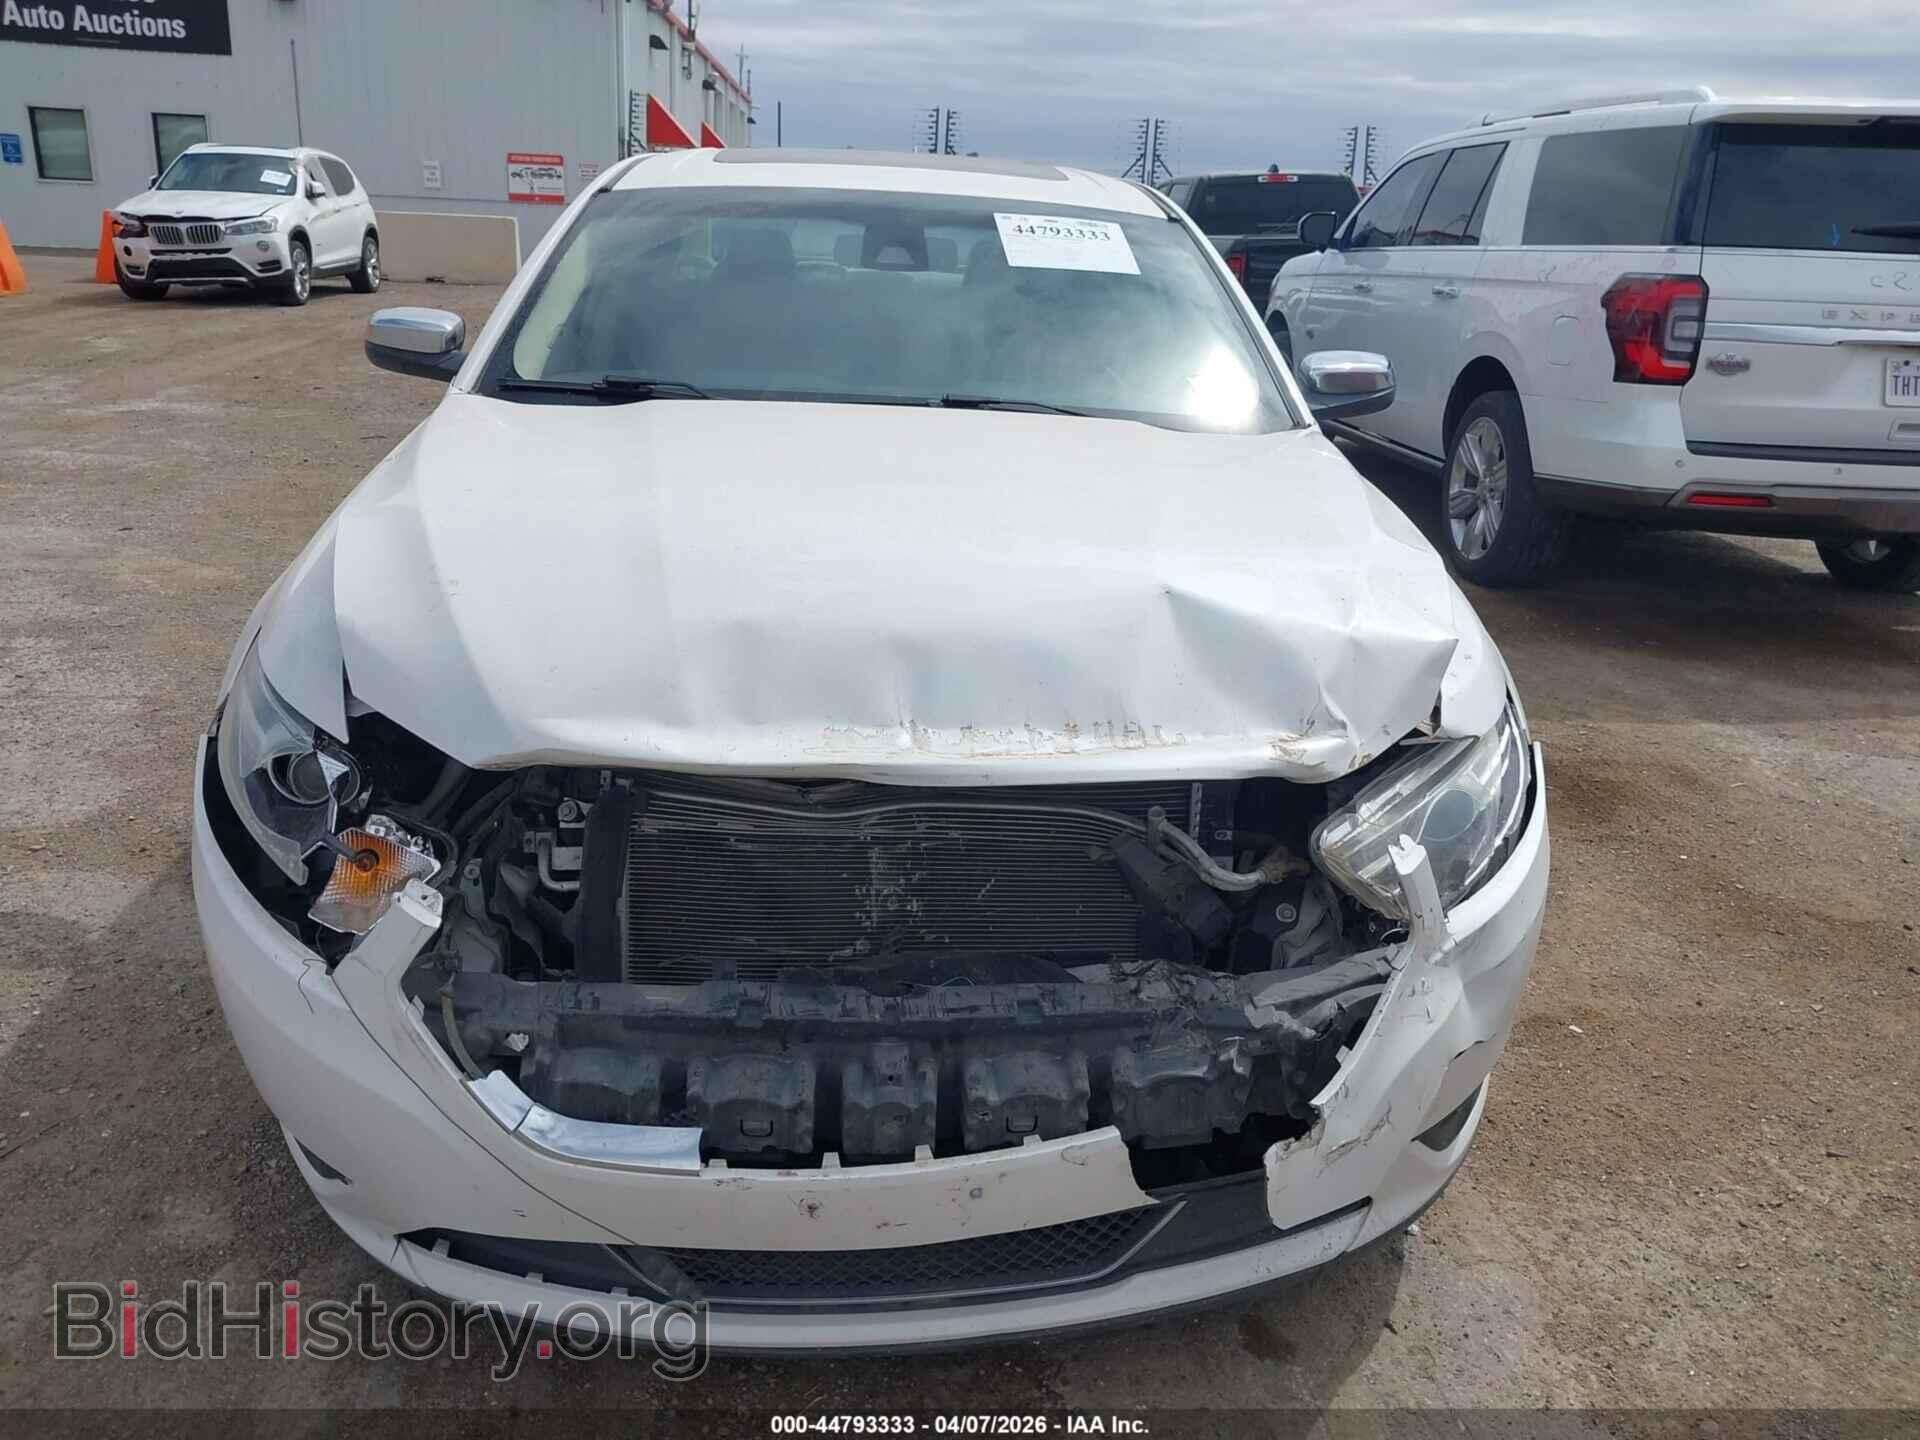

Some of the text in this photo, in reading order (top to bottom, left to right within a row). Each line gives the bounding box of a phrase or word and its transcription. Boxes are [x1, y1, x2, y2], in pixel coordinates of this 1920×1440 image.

[3, 0, 187, 39] Auto Auctions
[1012, 224, 1111, 241] 44793333
